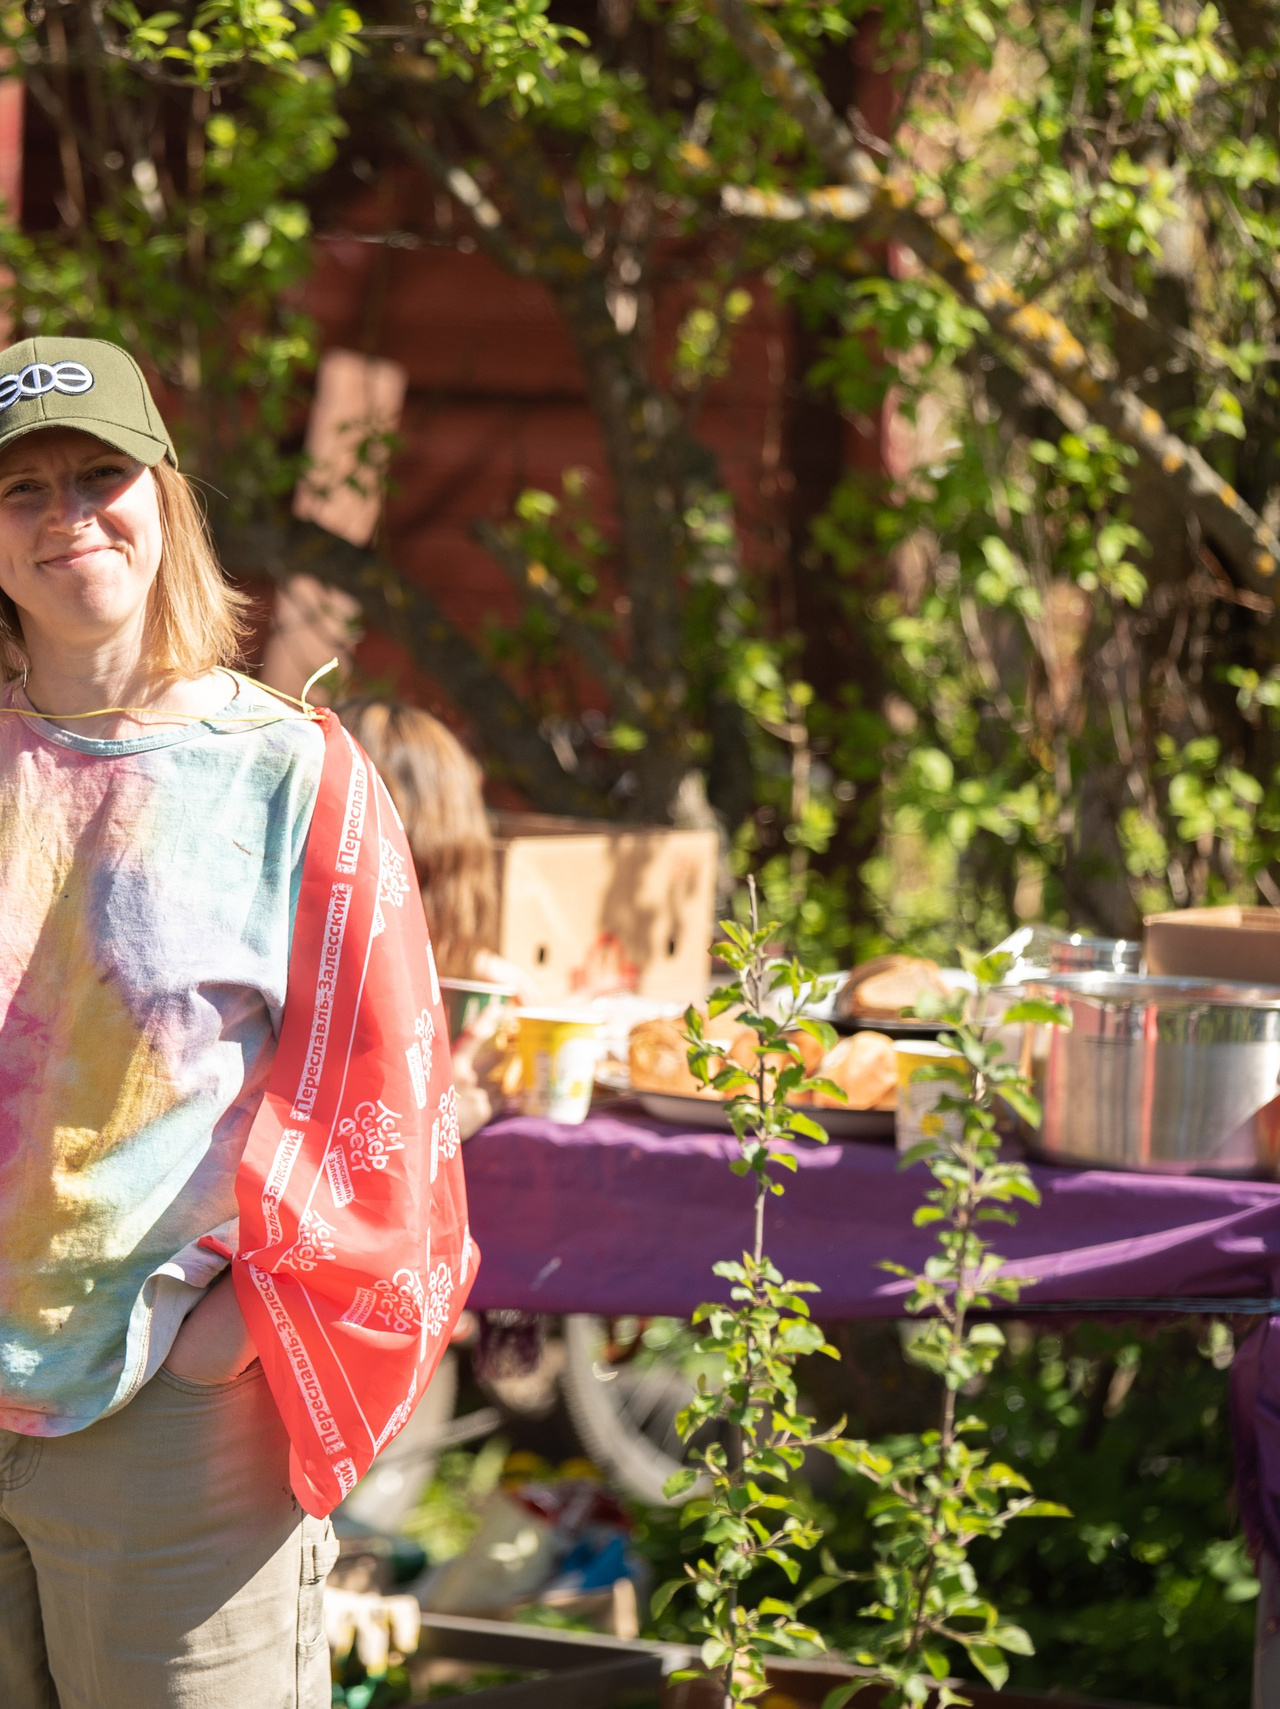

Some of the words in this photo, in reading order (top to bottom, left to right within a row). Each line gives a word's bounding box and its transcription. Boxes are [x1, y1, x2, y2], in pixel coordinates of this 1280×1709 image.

[294, 889, 348, 1115] Переславль-Залесский
[337, 1117, 371, 1172] Фест
[352, 1101, 390, 1170] Сойер
[376, 1100, 406, 1151] Том
[334, 1147, 353, 1200] Переславль
[311, 1209, 337, 1260] Том
[371, 1279, 398, 1326] Фест
[391, 1269, 417, 1333] Сойер
[253, 1265, 339, 1448] Переславль-Залесск
